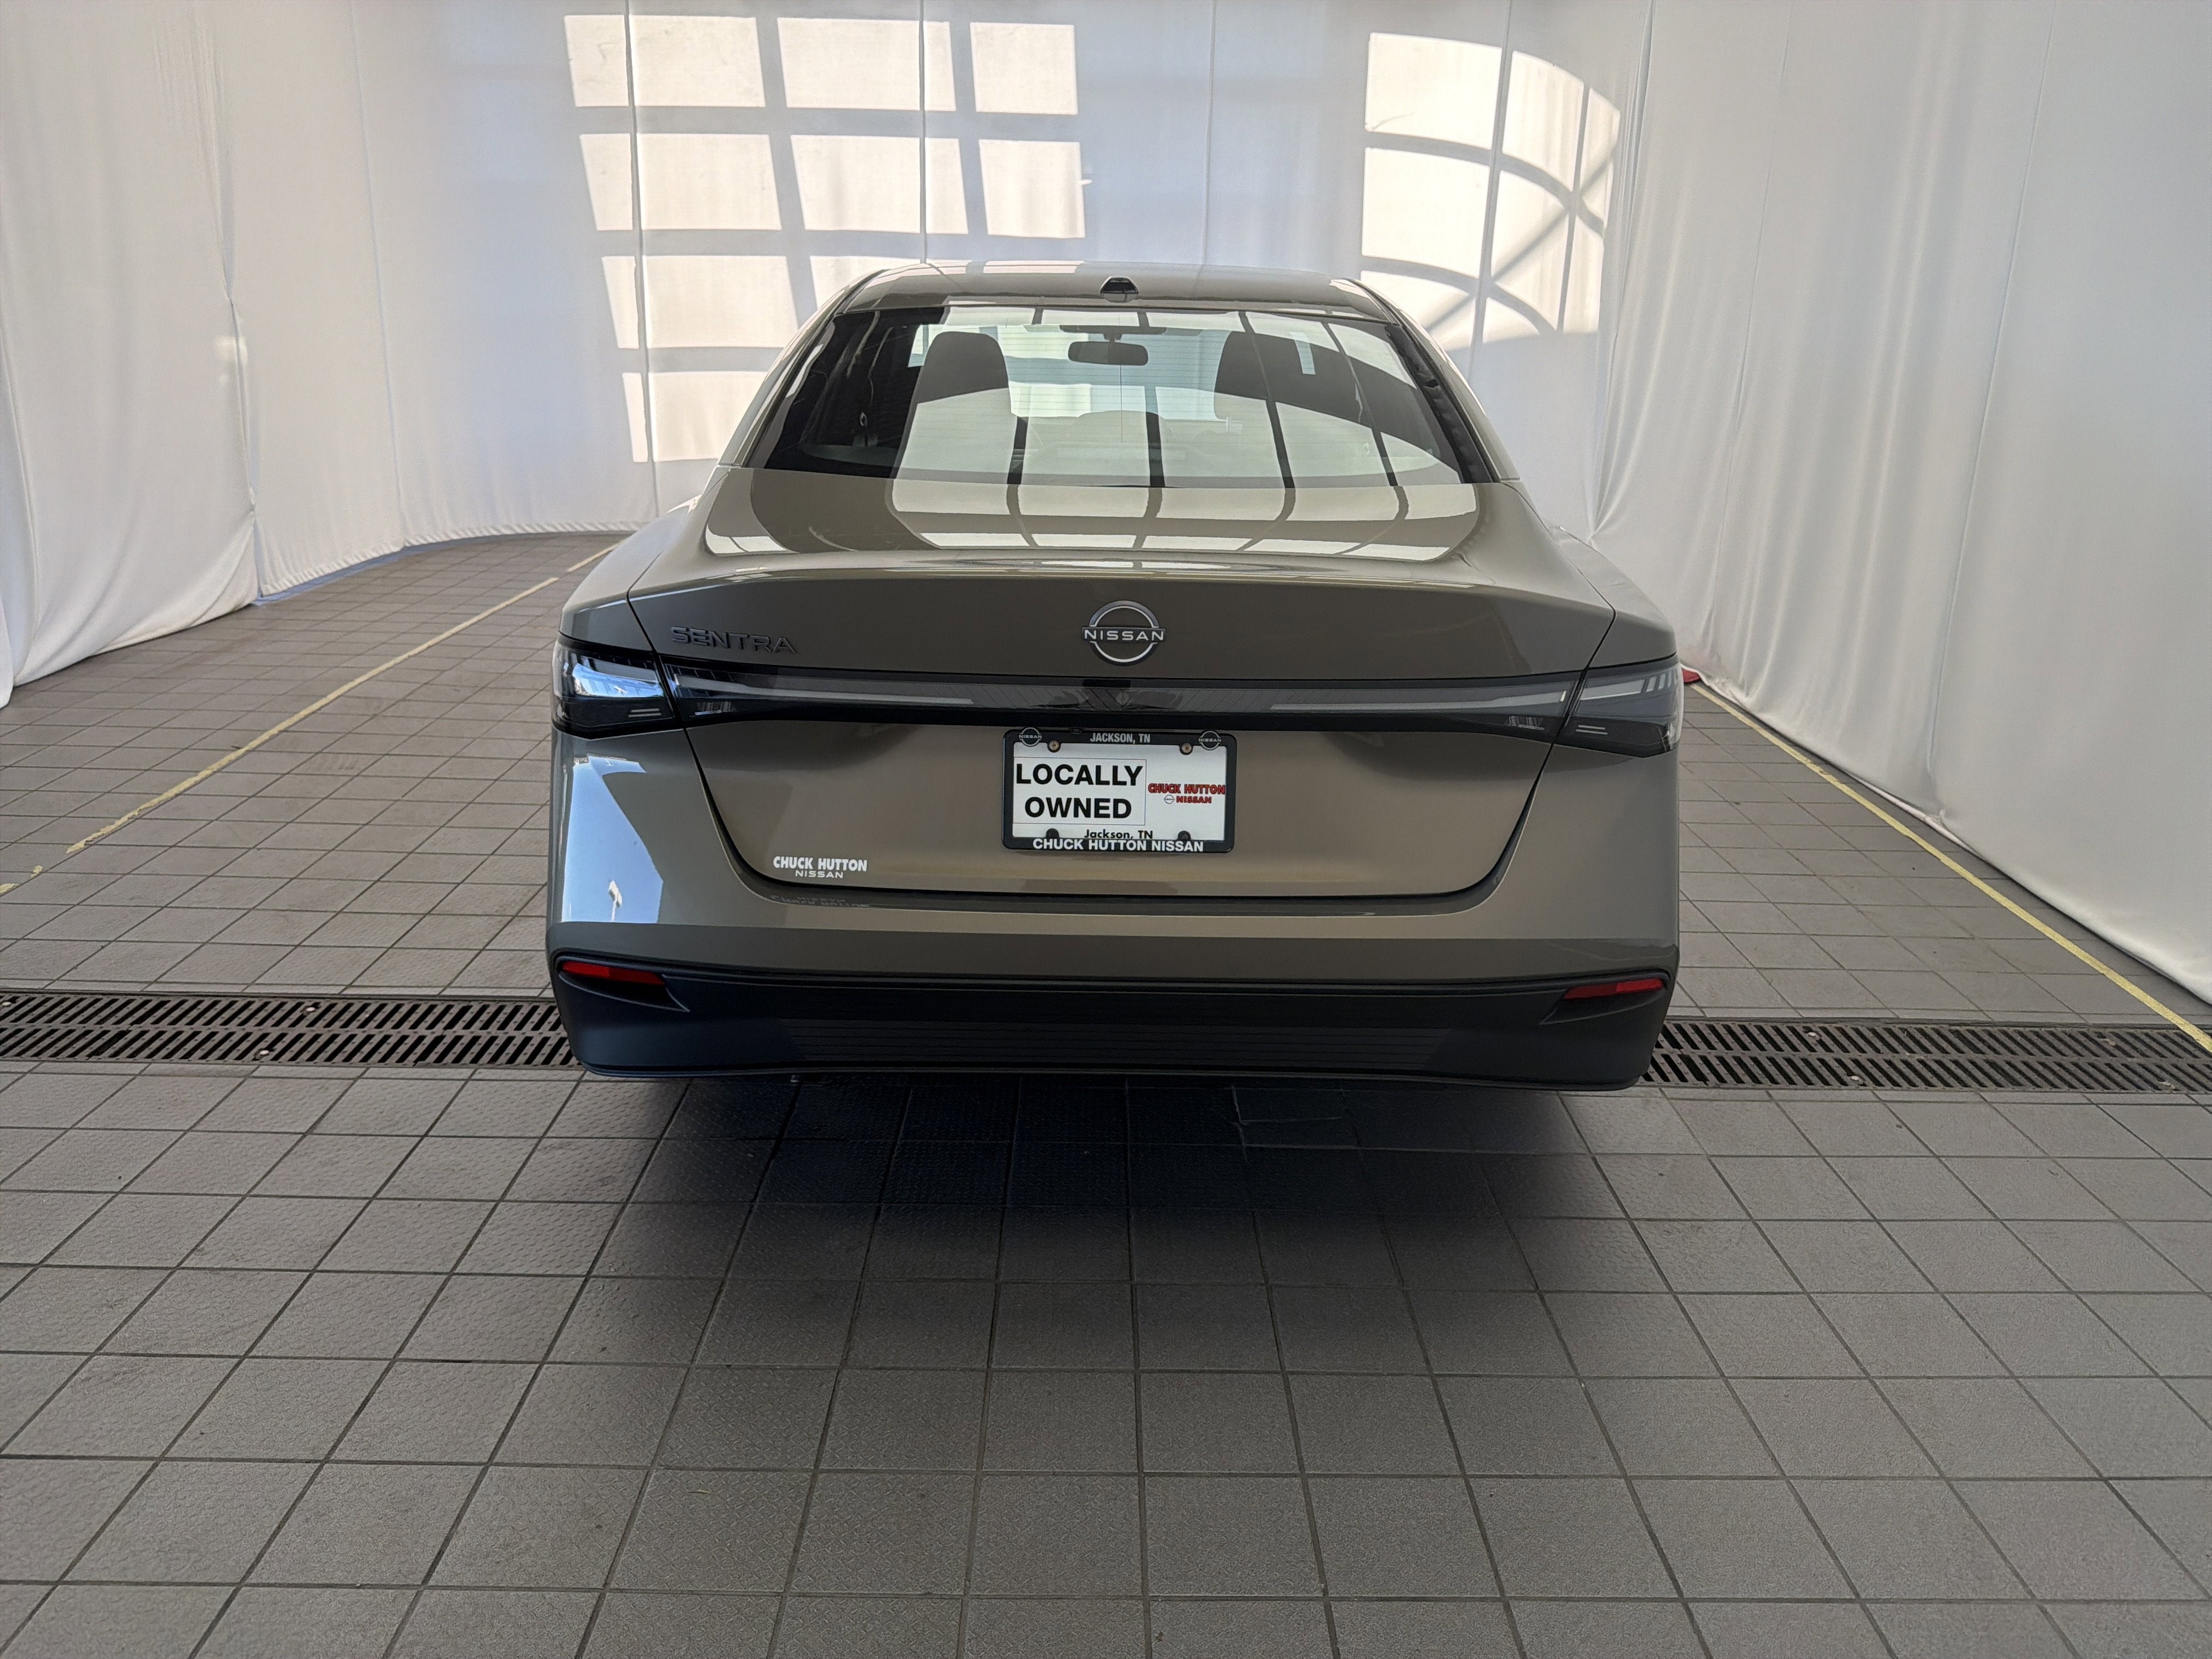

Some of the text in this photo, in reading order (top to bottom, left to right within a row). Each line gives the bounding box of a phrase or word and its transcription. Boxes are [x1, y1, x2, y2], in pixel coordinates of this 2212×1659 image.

[671, 626, 797, 653] SENTRA
[1084, 629, 1164, 641] NISSAN
[1090, 732, 1150, 744] JACKSON, TN
[1016, 763, 1144, 786] LOCALLY
[1148, 783, 1226, 794] CHUCK HUTTON
[1024, 797, 1132, 819] OWNED
[1084, 829, 1153, 840] Jackson, TN
[1033, 838, 1204, 852] CHUCK HUTTON NISSAN
[773, 856, 867, 872] CHUCK HUTTON
[795, 870, 844, 879] NISSAN
